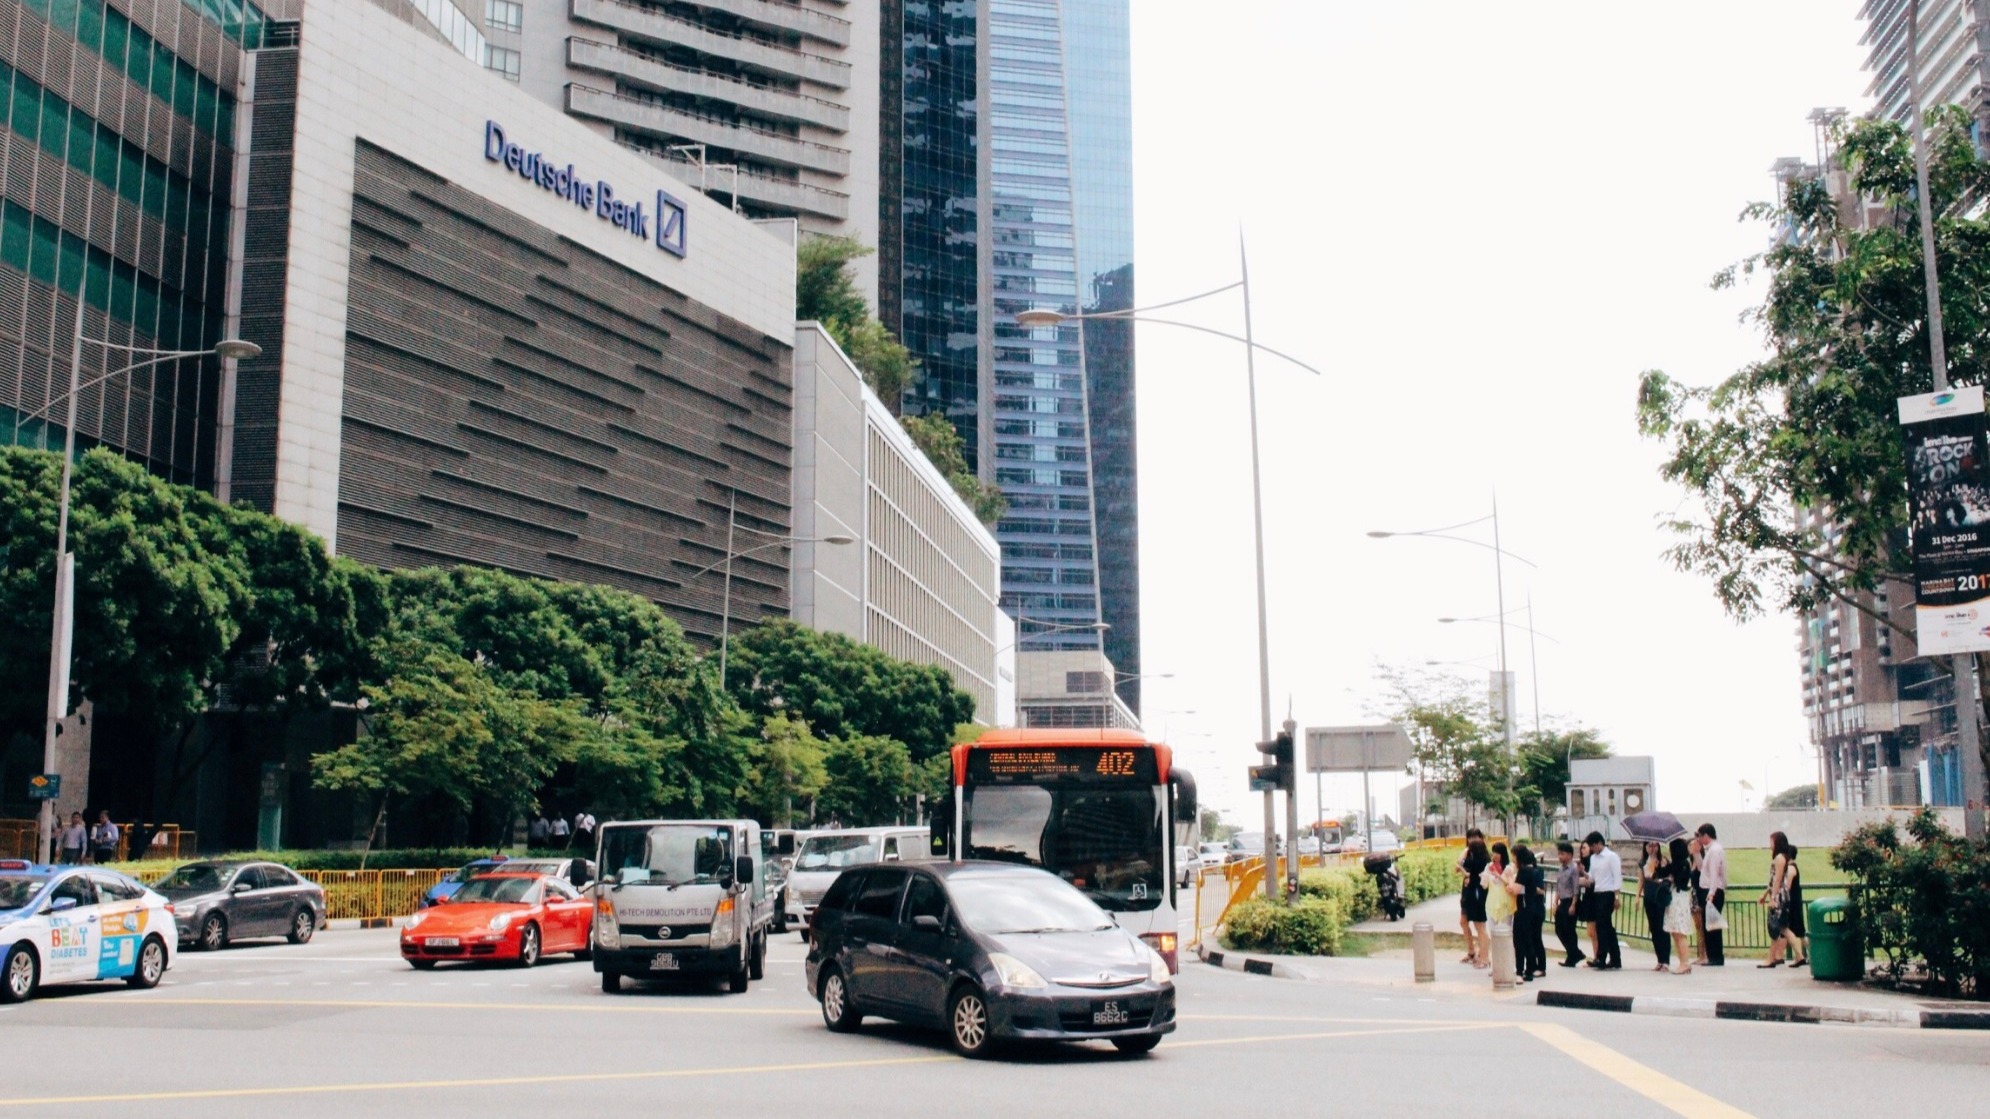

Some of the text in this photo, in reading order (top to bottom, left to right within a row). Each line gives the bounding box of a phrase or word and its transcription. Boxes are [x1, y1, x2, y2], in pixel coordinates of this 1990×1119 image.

[486, 120, 650, 240] Deutsche Bank
[1926, 442, 1973, 466] ROCK
[1929, 459, 1961, 482] ON
[1932, 537, 1941, 545] 31
[1957, 533, 1977, 542] 2016
[1921, 587, 1956, 595] COUNTDOWN
[1095, 751, 1136, 776] 402
[620, 907, 712, 917] HI-TECH DEMOLITION PTE LTD
[50, 917, 71, 927] LET'S
[51, 927, 88, 948] BEAT
[51, 947, 88, 959] DIABETES
[1104, 1001, 1118, 1011] ES
